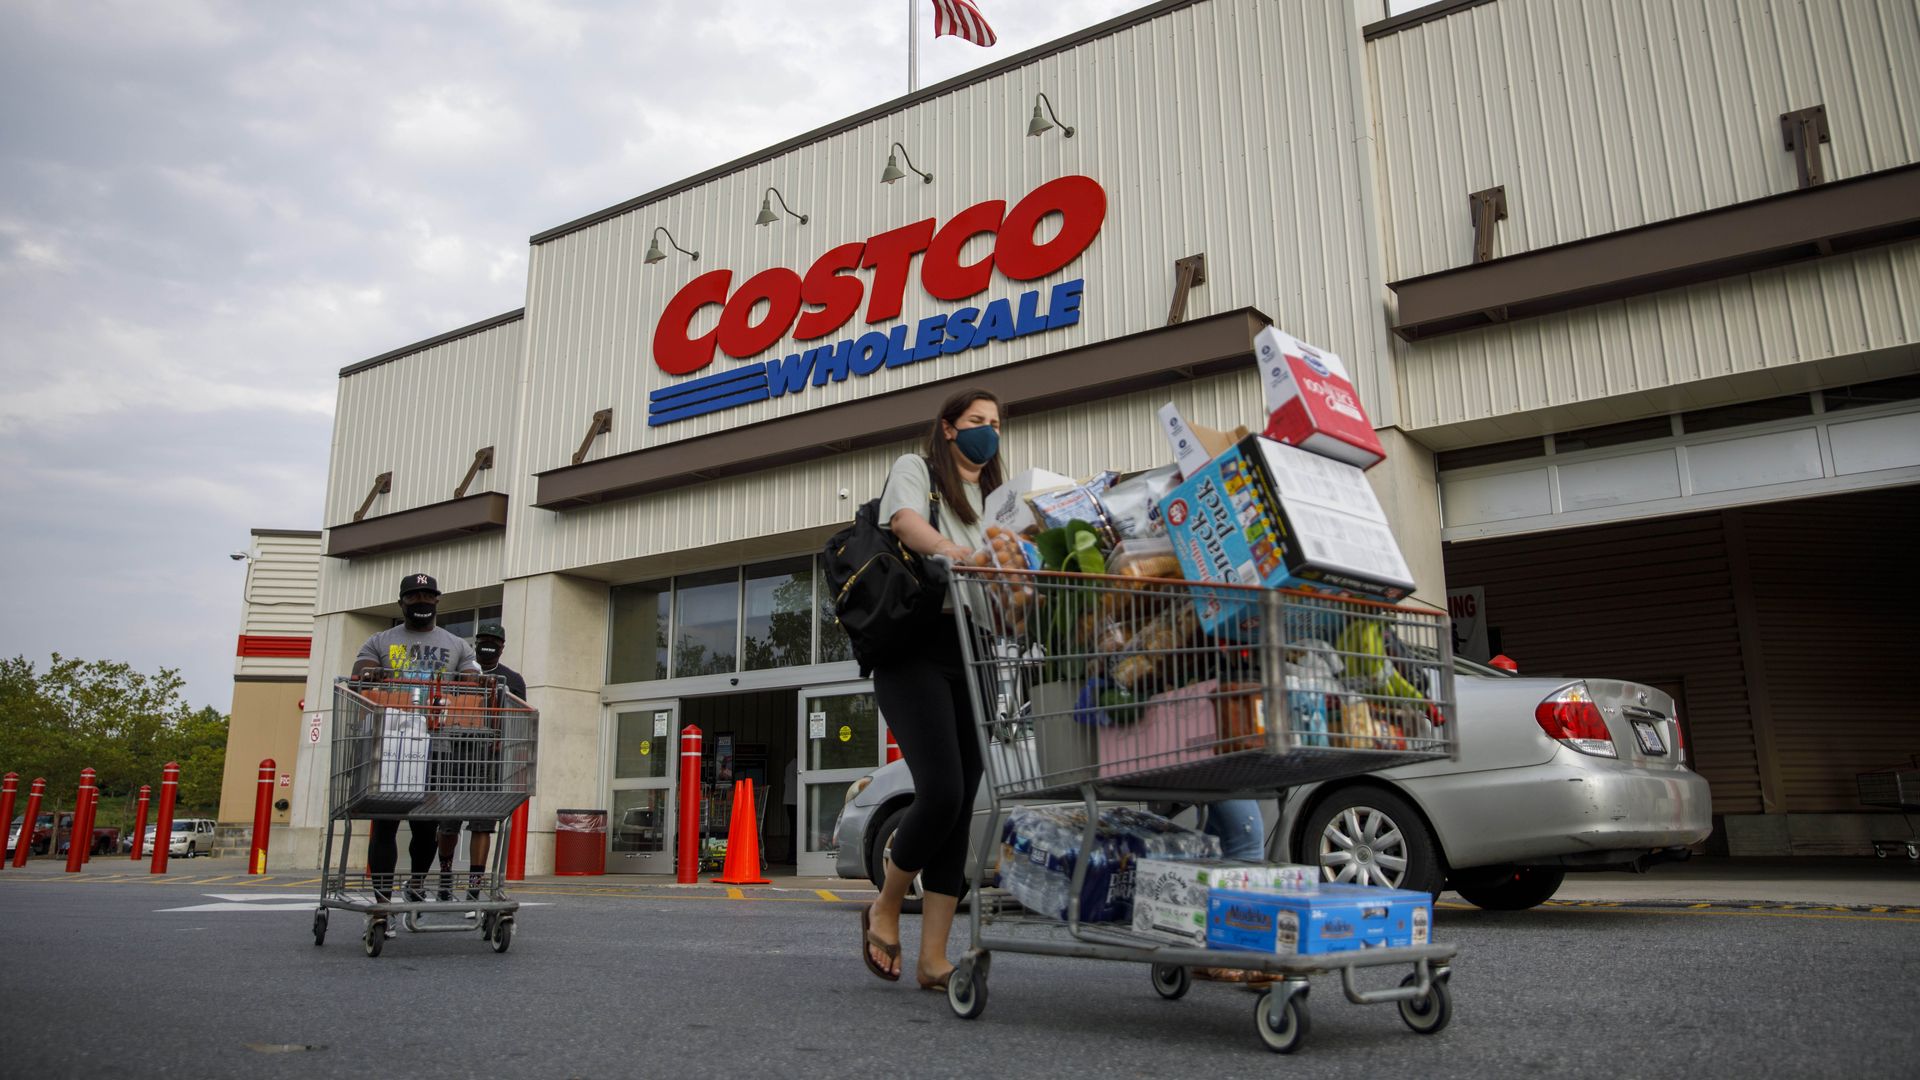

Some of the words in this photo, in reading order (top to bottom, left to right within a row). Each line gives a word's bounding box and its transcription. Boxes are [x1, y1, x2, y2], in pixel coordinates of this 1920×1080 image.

[653, 175, 1106, 375] COSTCO
[767, 278, 1084, 397] WHOLESALE
[1197, 476, 1237, 540] Pack
[1191, 507, 1238, 584] Snack
[1447, 594, 1476, 618] ING
[389, 643, 450, 663] MAKE
[403, 752, 426, 760] VODKA
[1154, 873, 1168, 901] WHITE
[1168, 871, 1188, 889] CLAW
